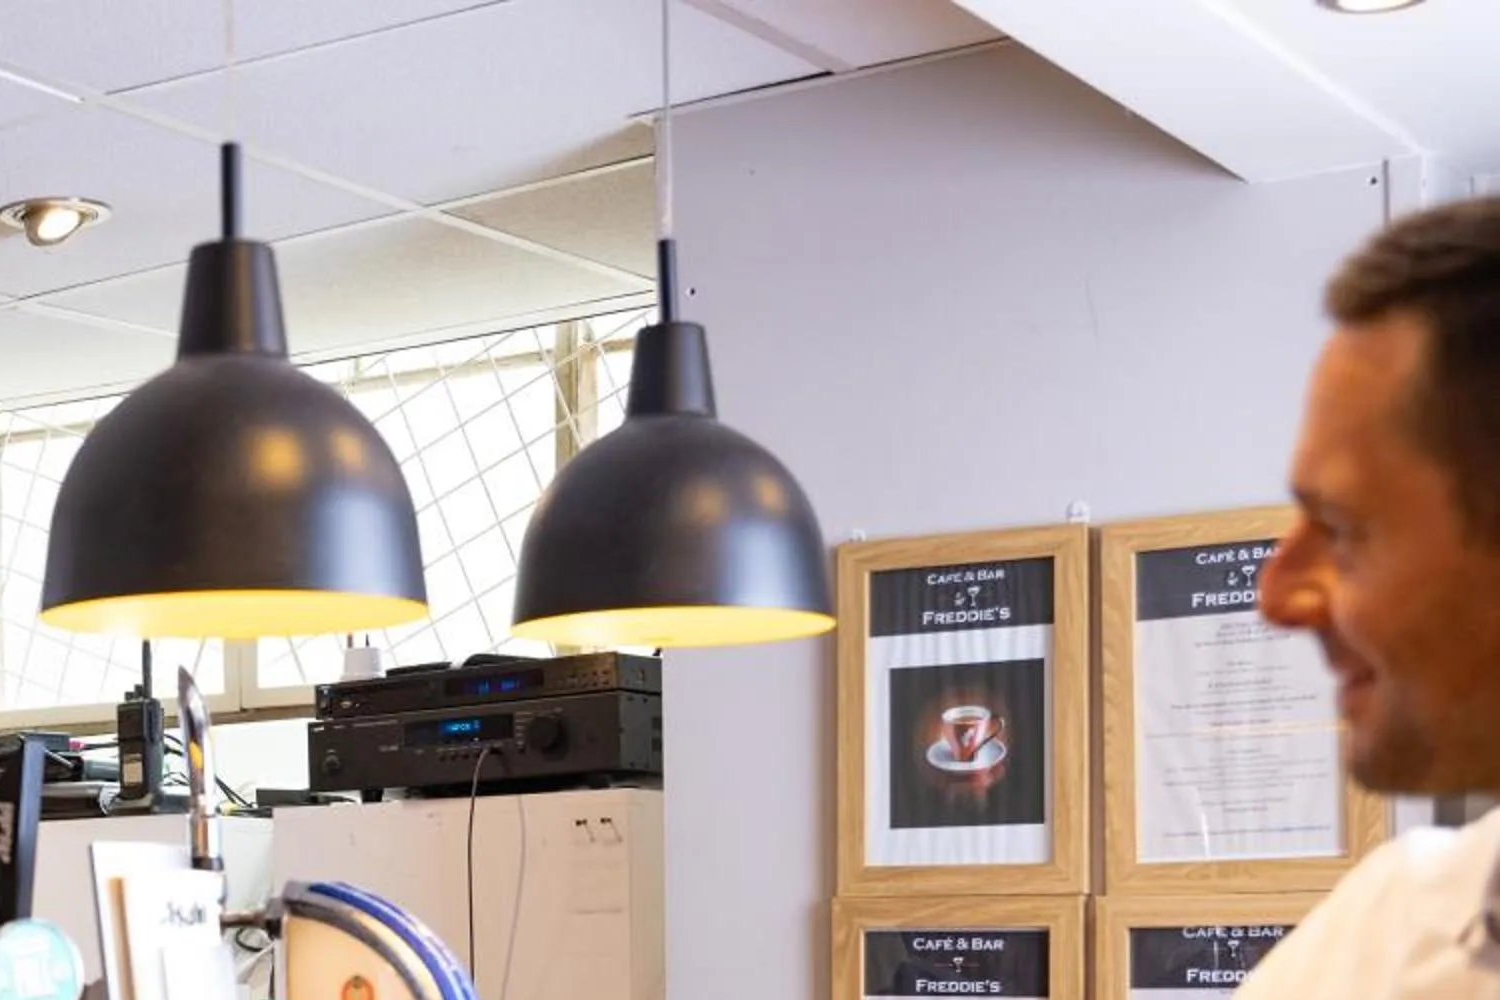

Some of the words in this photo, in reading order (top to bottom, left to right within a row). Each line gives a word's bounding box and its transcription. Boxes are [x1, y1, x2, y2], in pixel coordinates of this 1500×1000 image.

[1237, 549, 1249, 561] &
[963, 571, 975, 582] &
[977, 568, 1005, 581] BAR
[922, 606, 1011, 625] FREDDIE'S
[1231, 927, 1243, 937] &
[1248, 926, 1283, 937] BAR
[955, 938, 969, 950] &
[972, 937, 1004, 950] BAR
[915, 979, 1000, 993] FREDDIE'S
